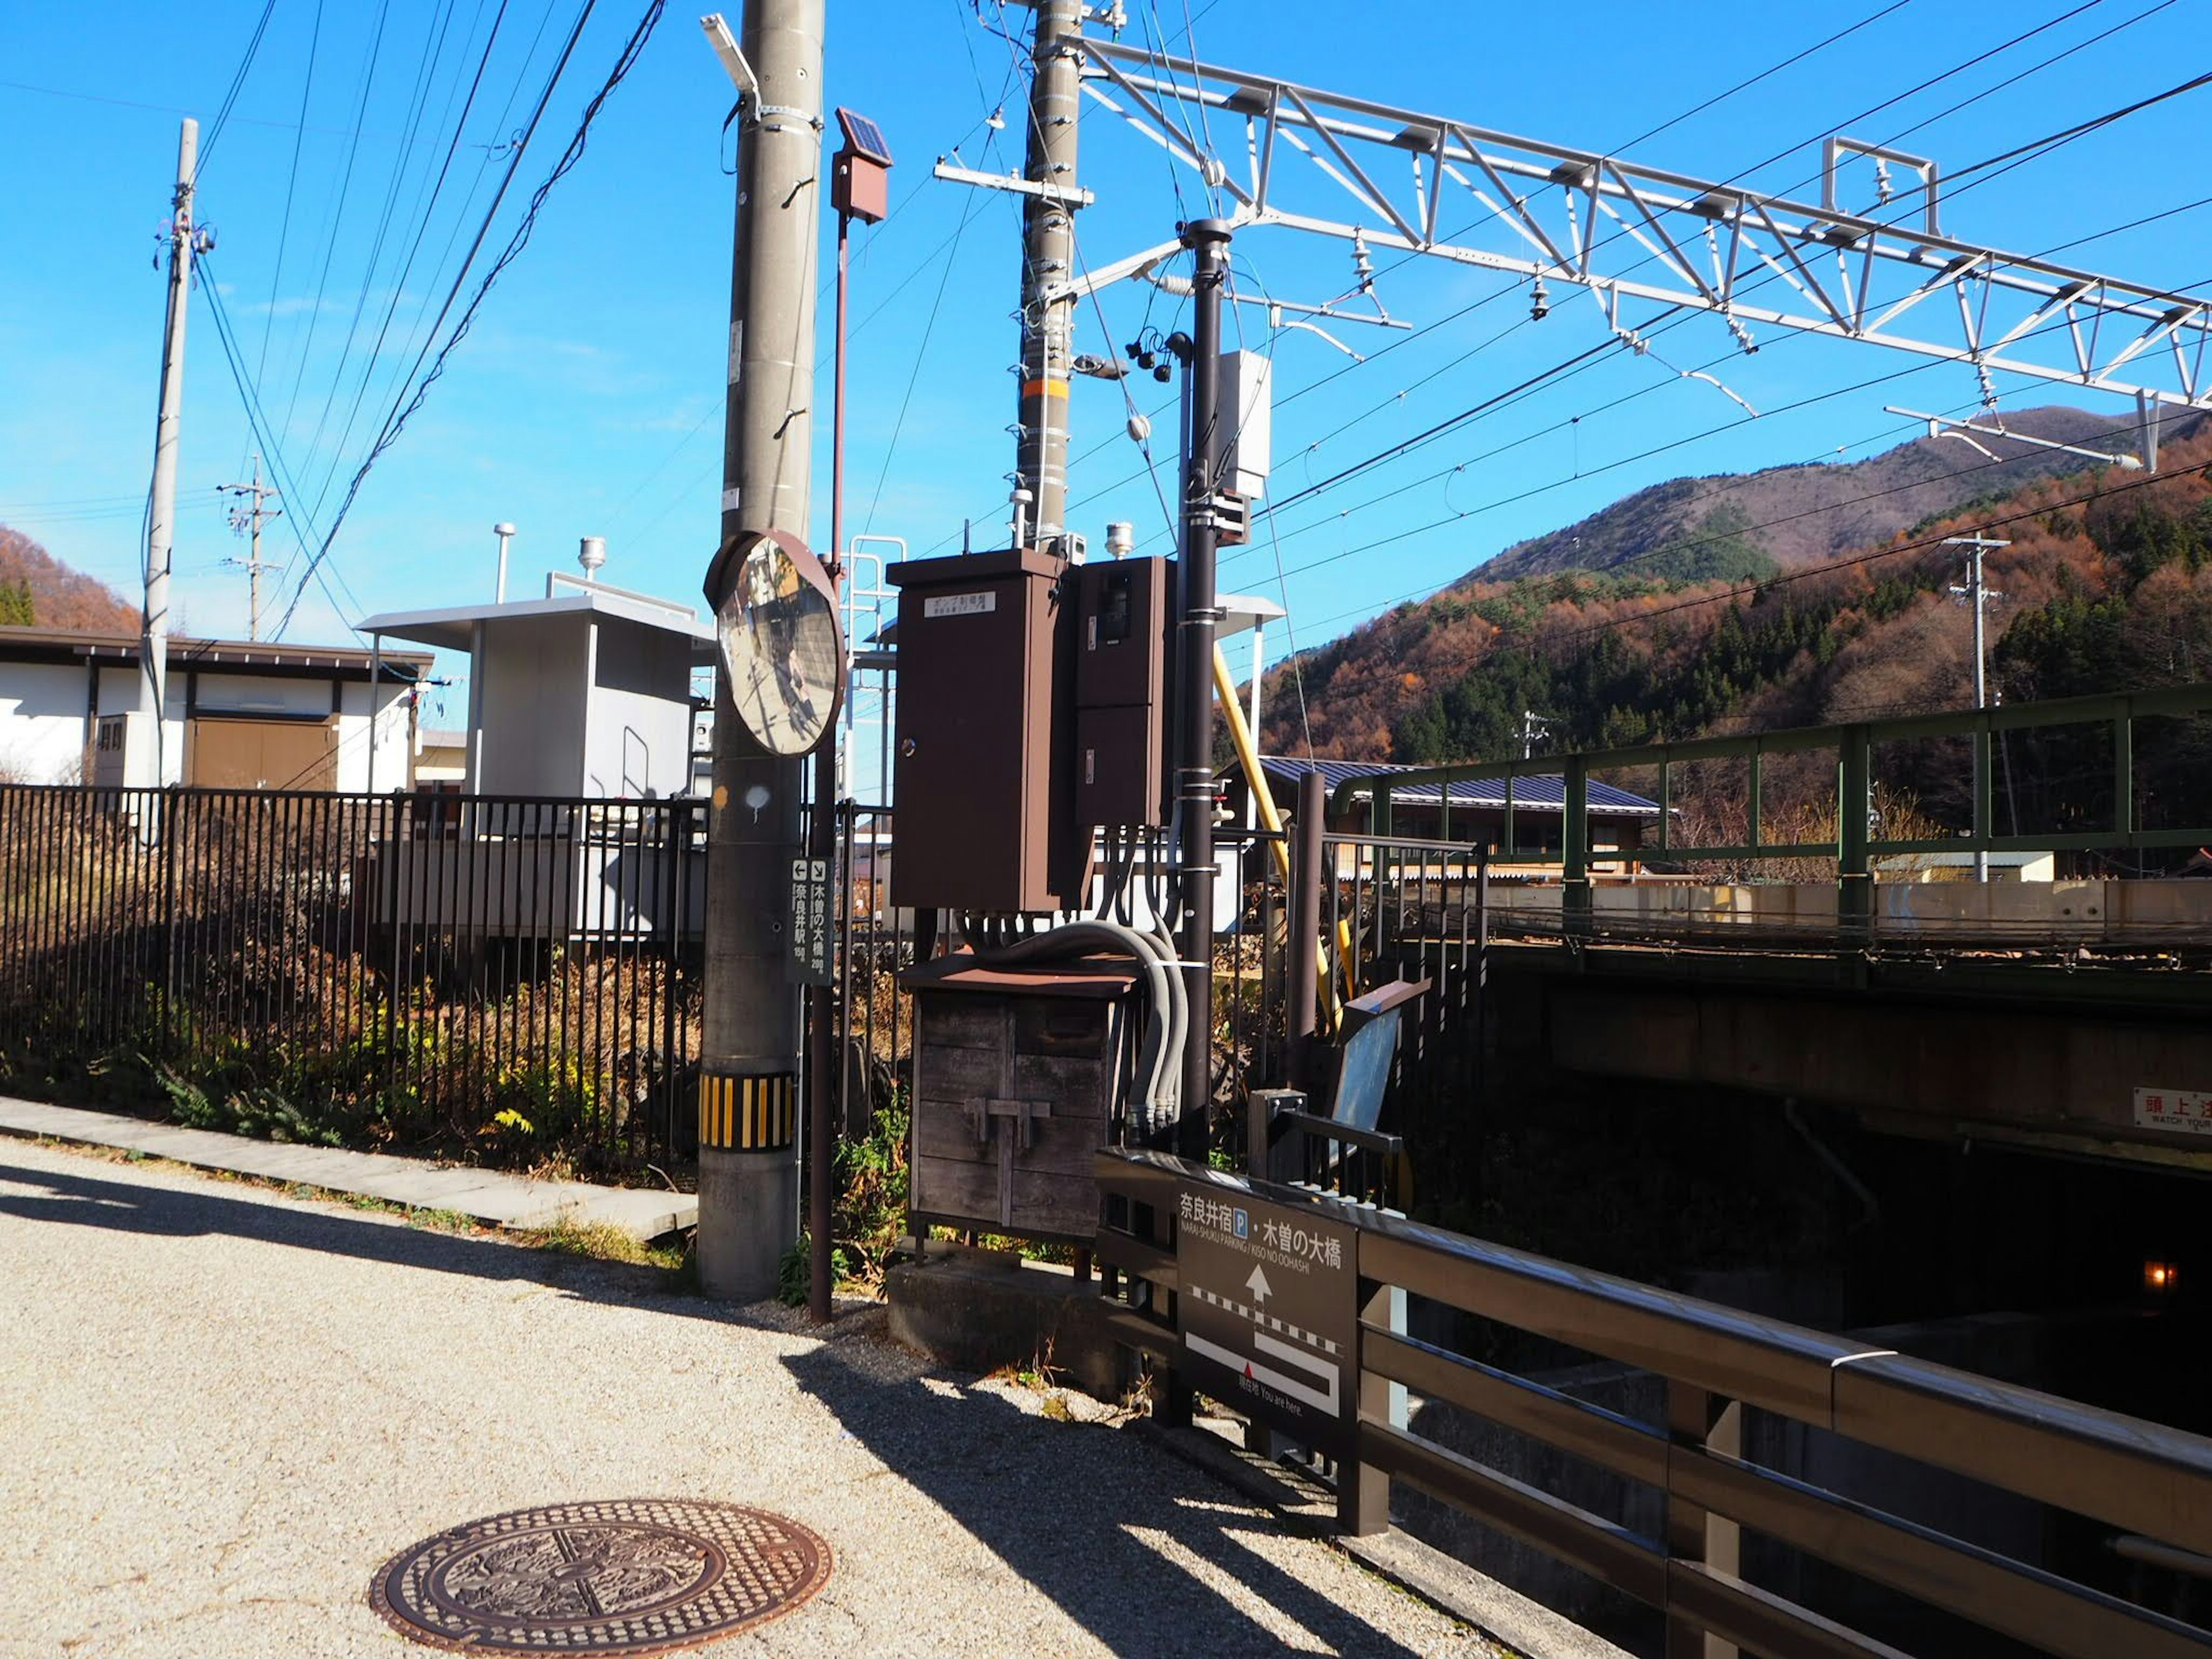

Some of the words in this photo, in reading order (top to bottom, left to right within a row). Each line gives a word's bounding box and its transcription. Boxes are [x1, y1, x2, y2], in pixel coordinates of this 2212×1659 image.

[794, 884, 806, 944] 奈良井駅
[813, 884, 825, 957] 木曽の大橋
[2152, 1115, 2182, 1124] WATCH
[1181, 1219, 1220, 1244] NARAI-SHUKU
[1220, 1233, 1247, 1252] PARKING
[1251, 1243, 1267, 1260] KISO
[1267, 1249, 1278, 1263] NO
[1278, 1253, 1310, 1275] OOHASHI
[1260, 1385, 1274, 1403] You
[1274, 1395, 1285, 1408] are
